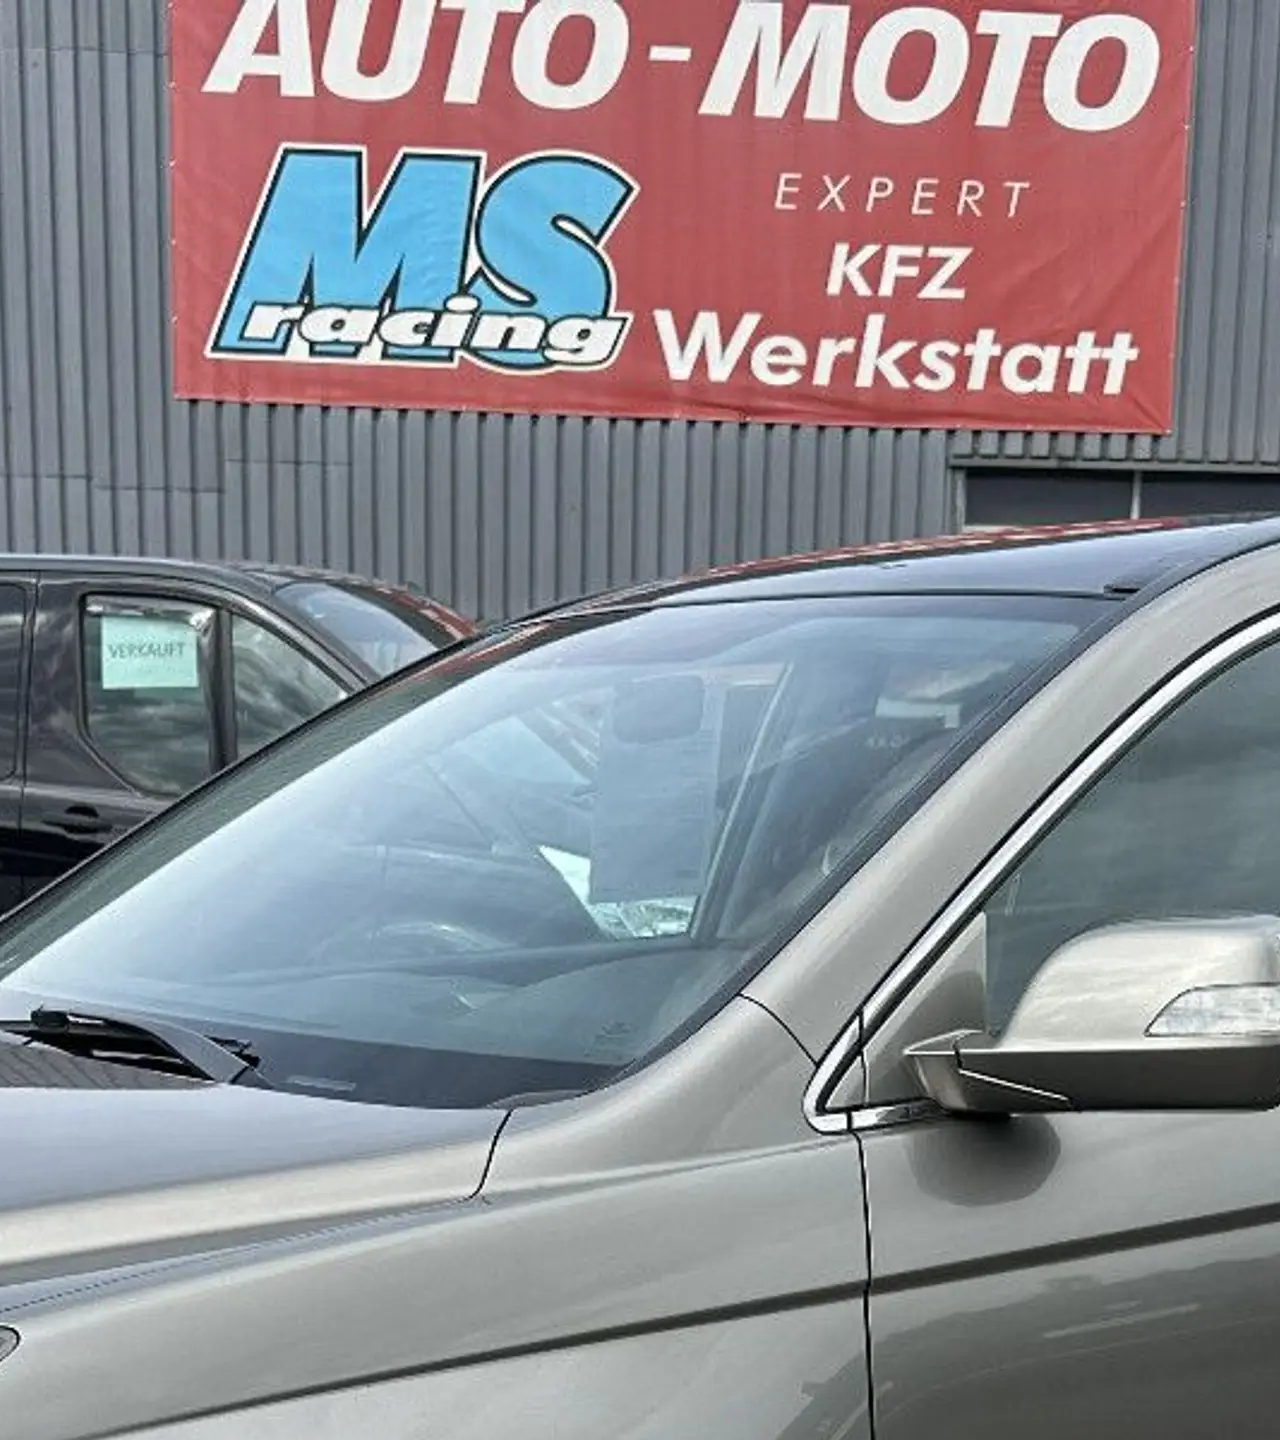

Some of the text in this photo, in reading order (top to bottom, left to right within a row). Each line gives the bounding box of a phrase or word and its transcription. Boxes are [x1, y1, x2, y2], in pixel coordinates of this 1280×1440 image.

[200, 0, 630, 110] AUTO
[698, 0, 1161, 132] MOTO
[775, 173, 1031, 217] EXPERT
[208, 144, 639, 372] MS
[826, 242, 974, 301] KFZ
[240, 296, 628, 365] racing
[653, 308, 1140, 395] Werkstatt
[107, 642, 186, 659] VERKAUFT
